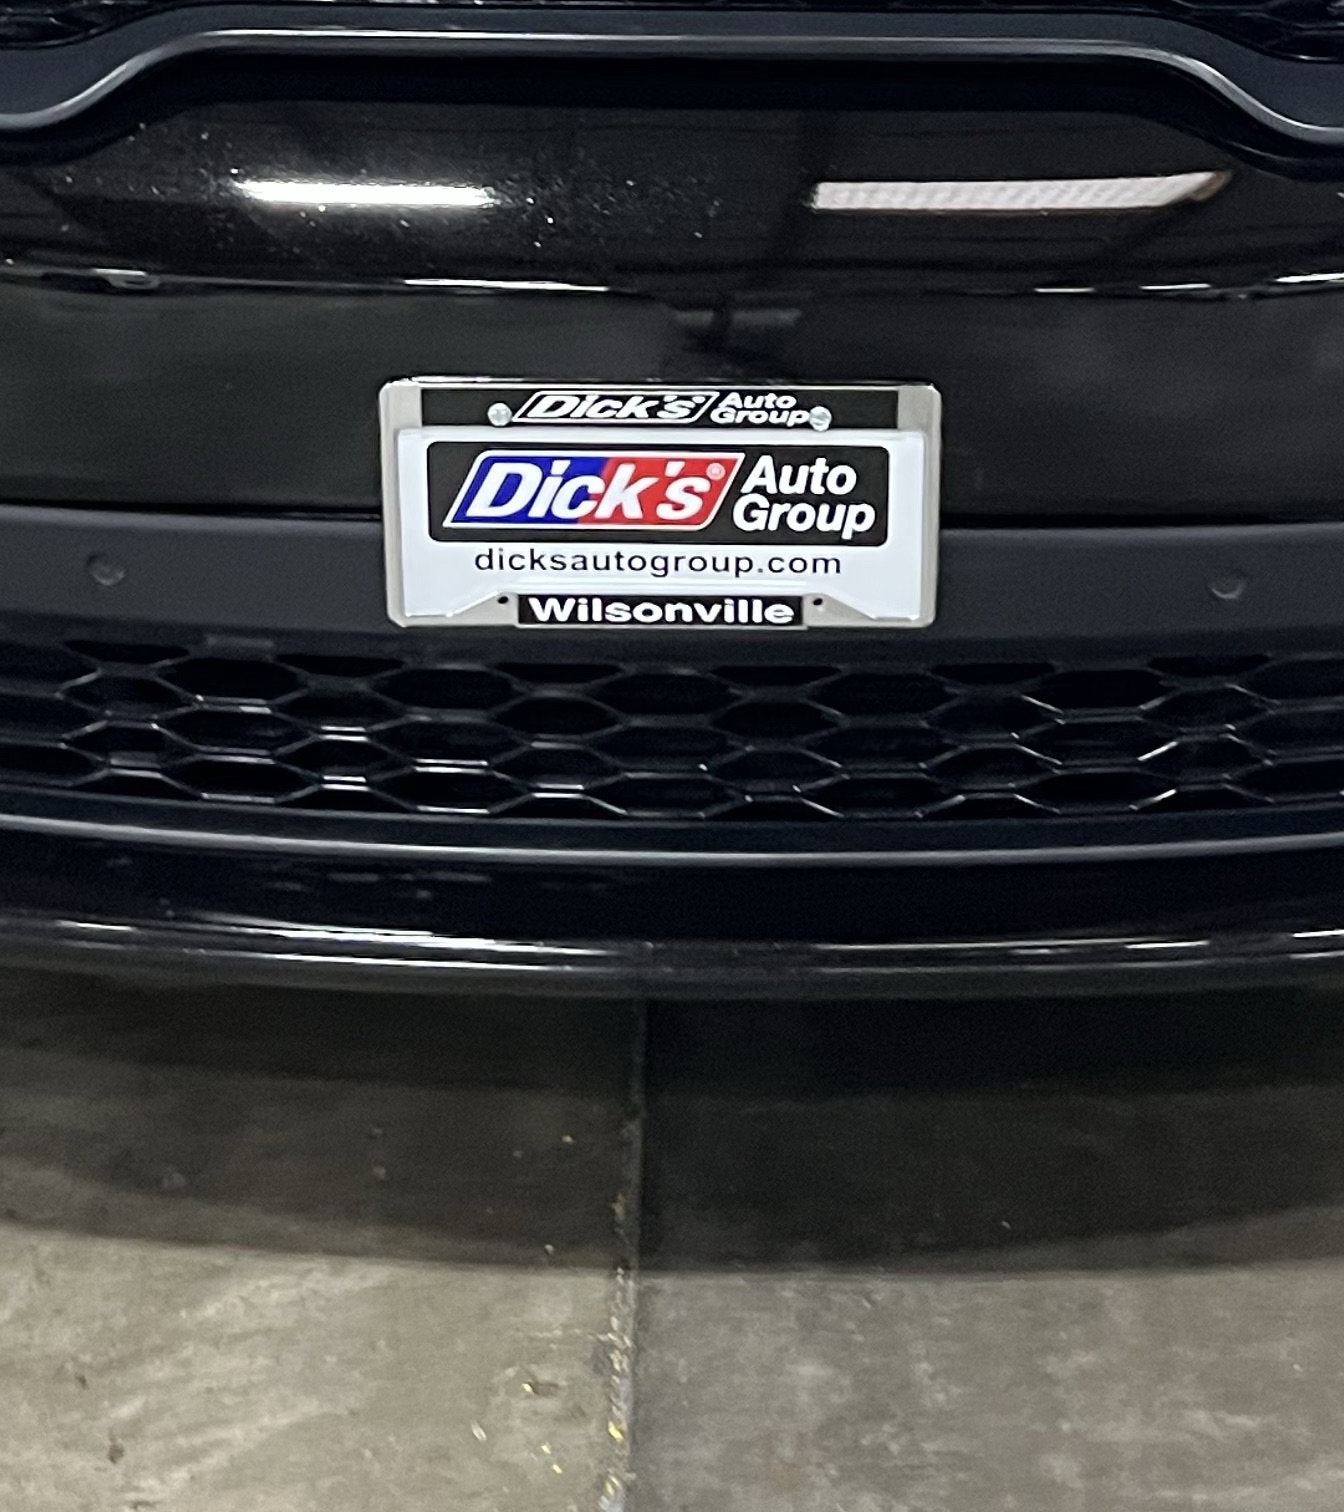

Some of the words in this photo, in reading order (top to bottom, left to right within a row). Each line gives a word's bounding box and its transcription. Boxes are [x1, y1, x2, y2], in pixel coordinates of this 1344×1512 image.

[527, 393, 696, 419] Dick's
[718, 392, 797, 410] Auto
[710, 407, 810, 427] Group
[465, 459, 711, 521] Dick's
[741, 455, 856, 495] Auto
[733, 494, 876, 539] Group
[474, 548, 842, 578] dicksautogroup.com
[529, 597, 796, 625] Wilsonville
